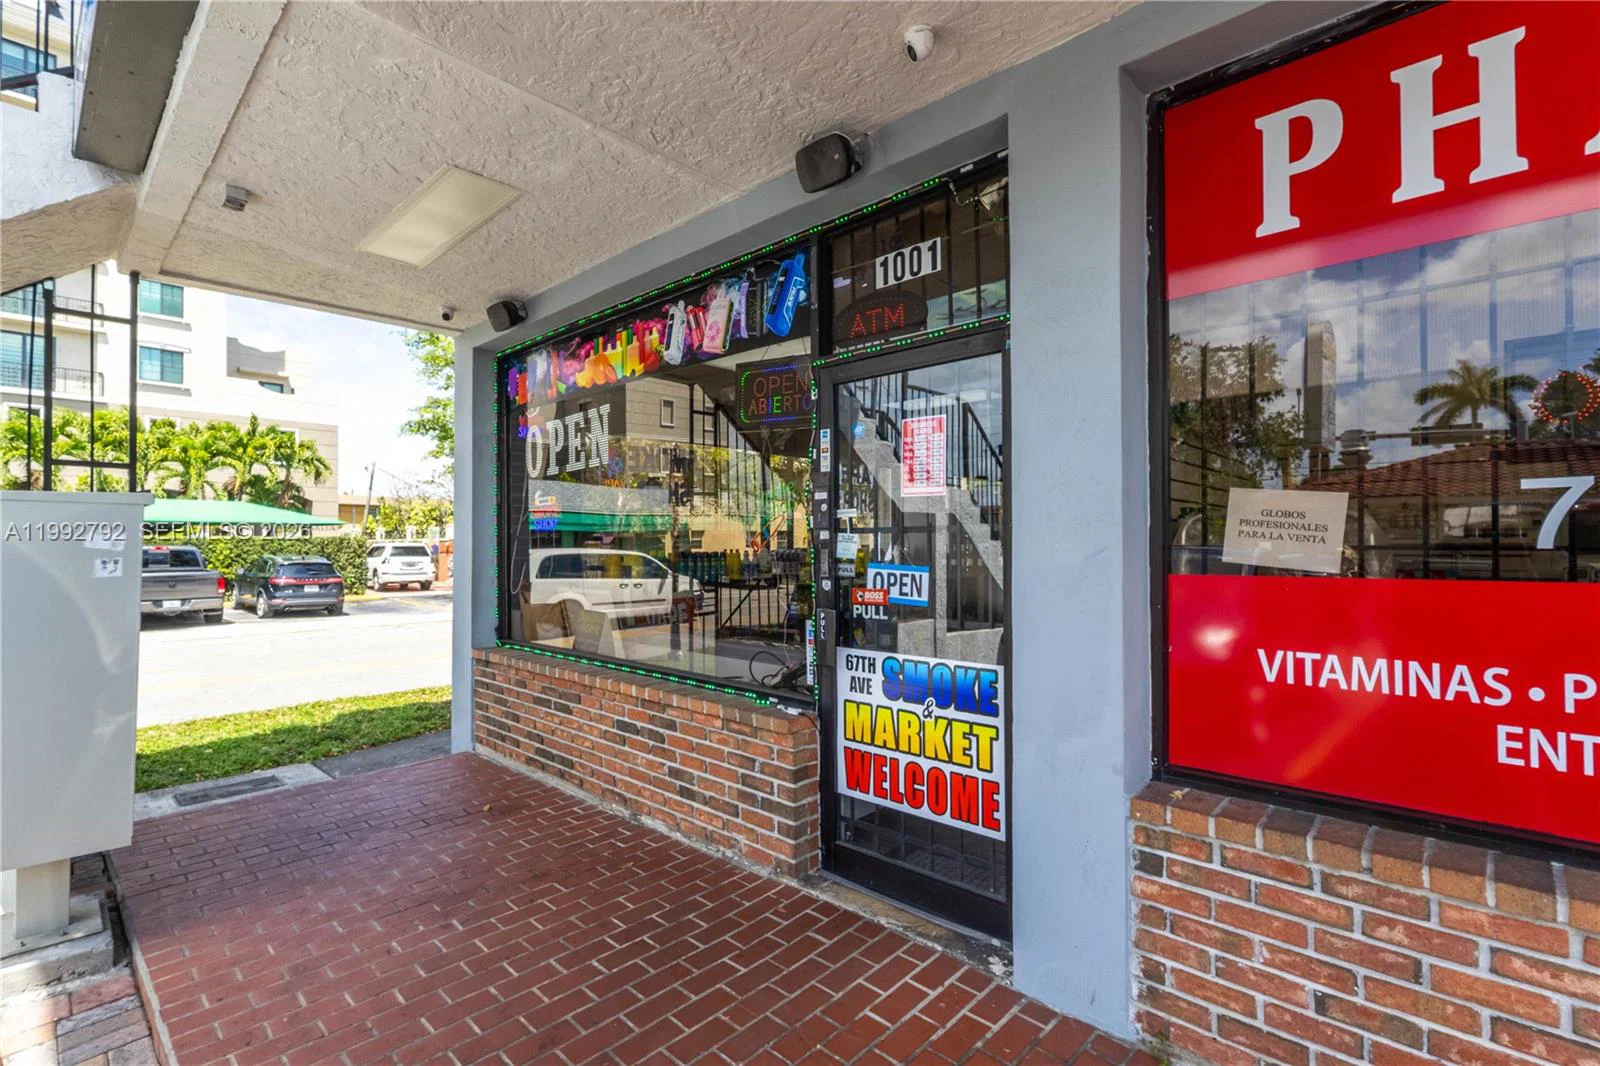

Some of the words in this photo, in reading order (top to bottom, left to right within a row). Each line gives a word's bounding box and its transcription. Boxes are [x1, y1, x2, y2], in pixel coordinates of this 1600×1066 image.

[1254, 26, 1600, 238] PH
[880, 239, 938, 286] 1001
[851, 303, 905, 338] ATM
[753, 371, 808, 397] OPEN
[748, 393, 812, 416] ABIERTO
[526, 404, 610, 478] OPEN
[534, 518, 558, 530] SHOP
[1239, 518, 1328, 533] PROFESIONALES
[1261, 508, 1306, 520] GLOBOS
[1520, 476, 1595, 549] 7
[1238, 529, 1266, 540] PARA
[1269, 532, 1284, 541] LA
[1287, 533, 1327, 544] VENTA
[864, 591, 885, 600] BOSS
[872, 571, 924, 598] OPEN
[853, 604, 889, 620] PULL
[846, 654, 876, 675] 67TH
[1257, 648, 1512, 707] VITAMINAS
[849, 675, 872, 695] AVE
[882, 656, 999, 717] SMOKE
[922, 699, 934, 719] &
[844, 698, 999, 773] MARKET
[1496, 724, 1600, 777] ENT
[843, 746, 1001, 832] WELCOME
